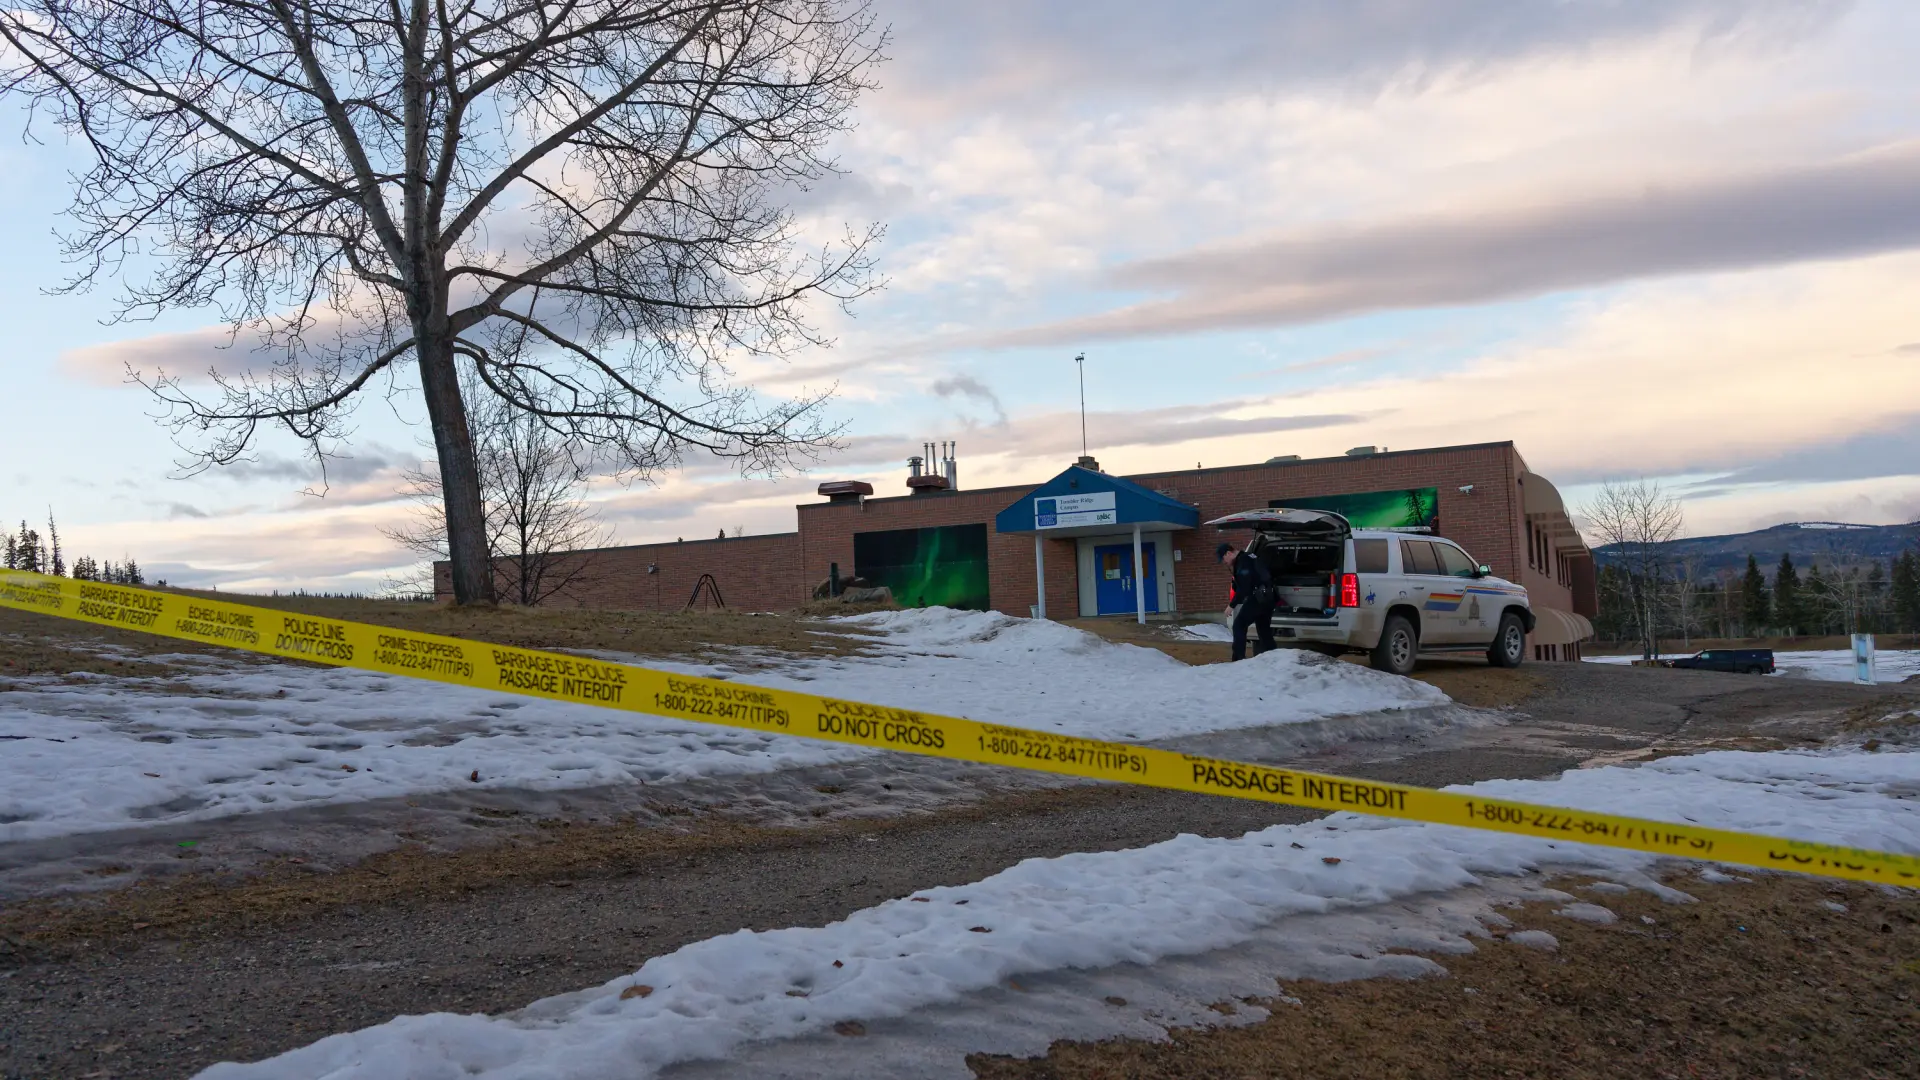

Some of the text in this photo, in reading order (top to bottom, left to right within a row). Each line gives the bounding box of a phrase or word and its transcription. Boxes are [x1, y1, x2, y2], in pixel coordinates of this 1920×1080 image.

[80, 585, 163, 612] BARRAGE DE POLICE
[77, 601, 158, 628] PASSAGE INTERDIT
[216, 612, 227, 623] AU
[228, 612, 254, 628] CRIME
[284, 618, 346, 641] POLICE LINE
[275, 633, 354, 660] DO NOT CROSS
[378, 634, 464, 659] CRIME STOPPERS
[492, 650, 628, 684] BARRAGE DE POLICE
[499, 668, 624, 703] PASSAGE INTERDIT
[714, 687, 732, 700] AU
[733, 689, 777, 706] CRIME
[821, 700, 928, 725] POLICE LINE
[818, 713, 945, 748] DO NOT CROSS
[1193, 764, 1409, 811] PASSAGE INTERDIT
